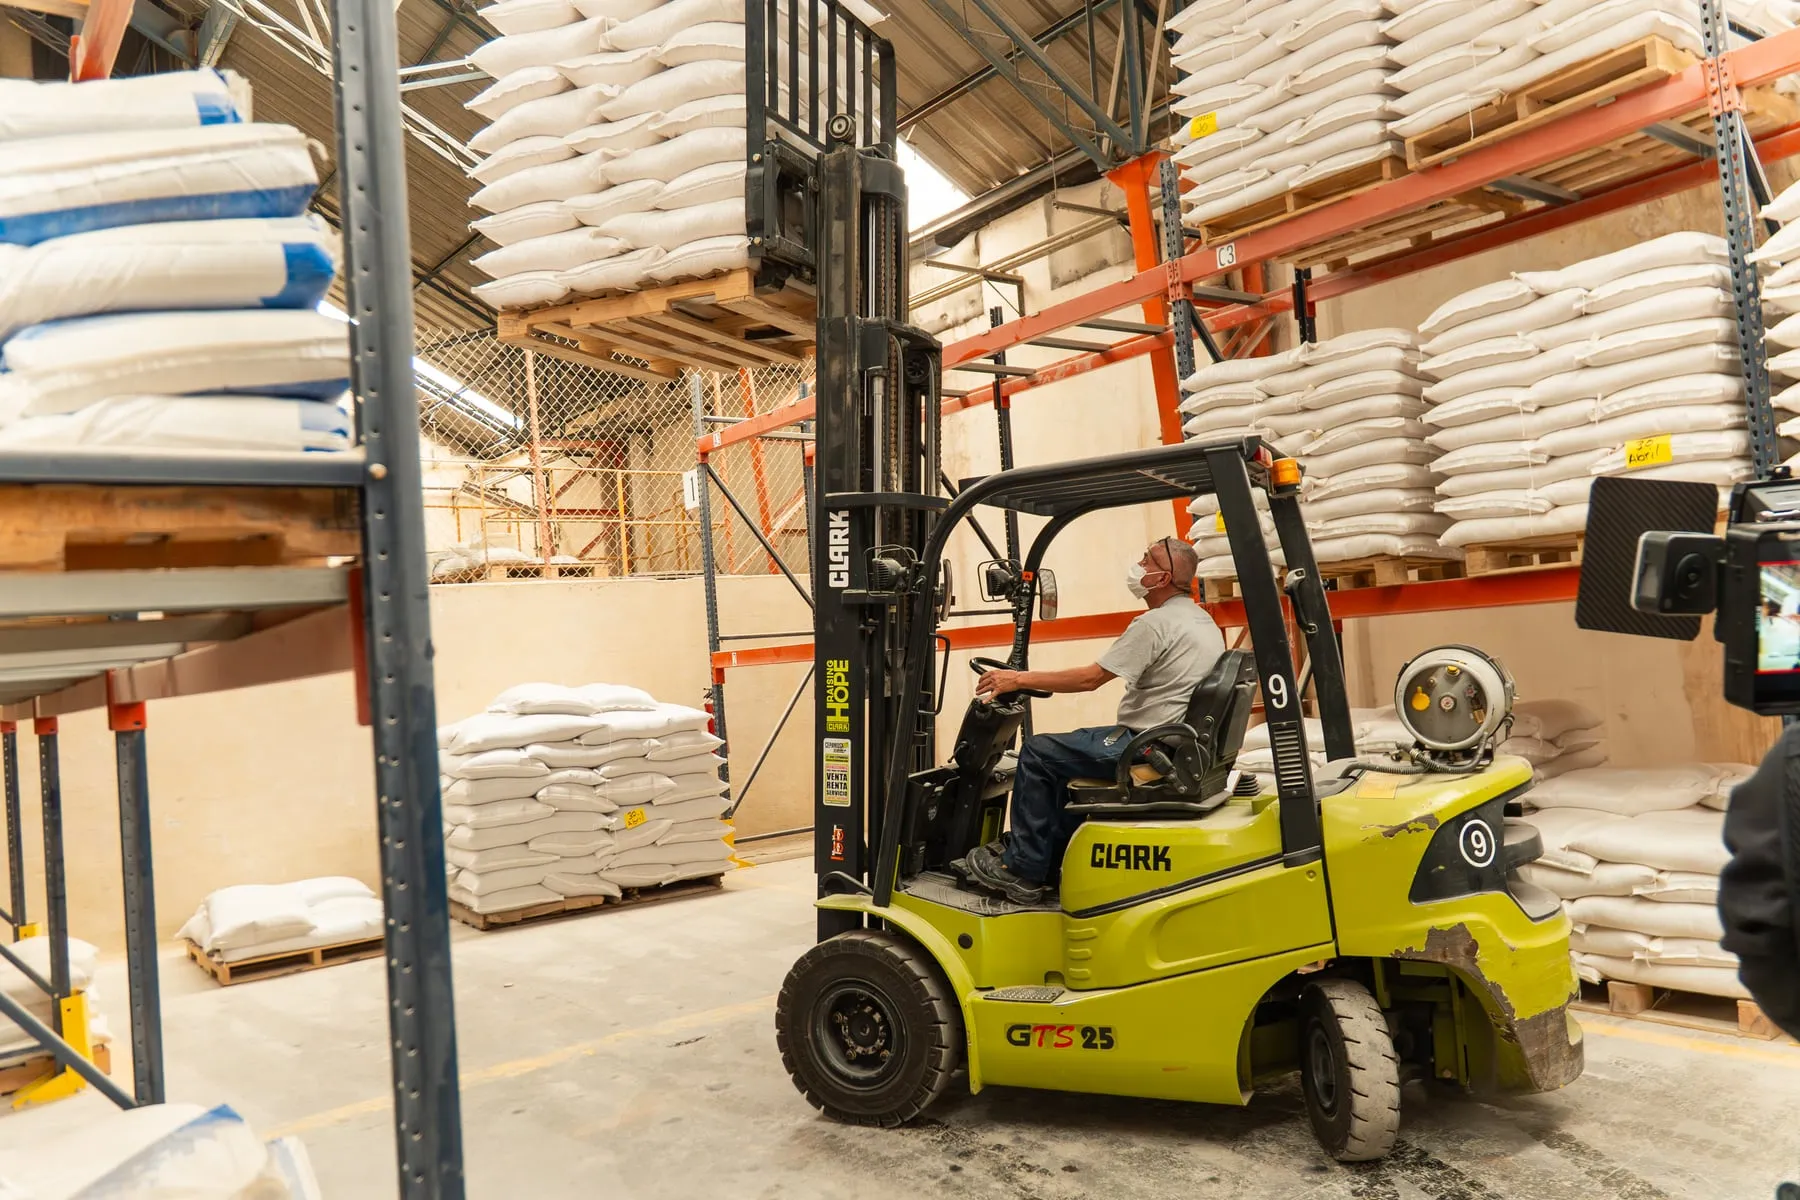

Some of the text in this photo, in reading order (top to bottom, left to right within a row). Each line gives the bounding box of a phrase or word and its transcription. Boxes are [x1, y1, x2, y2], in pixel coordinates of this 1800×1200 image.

[1218, 244, 1235, 267] C3
[829, 510, 850, 588] CLARK
[826, 659, 834, 703] RAISING
[826, 659, 849, 723] HOPE
[1268, 673, 1288, 709] 9
[828, 723, 849, 731] CLARK
[826, 772, 848, 782] VENTA
[826, 781, 848, 790] RENTA
[826, 789, 848, 797] SERVICIO
[1091, 842, 1171, 872] CLARK
[1470, 829, 1487, 858] 9
[1006, 1024, 1115, 1050] GTS 25
